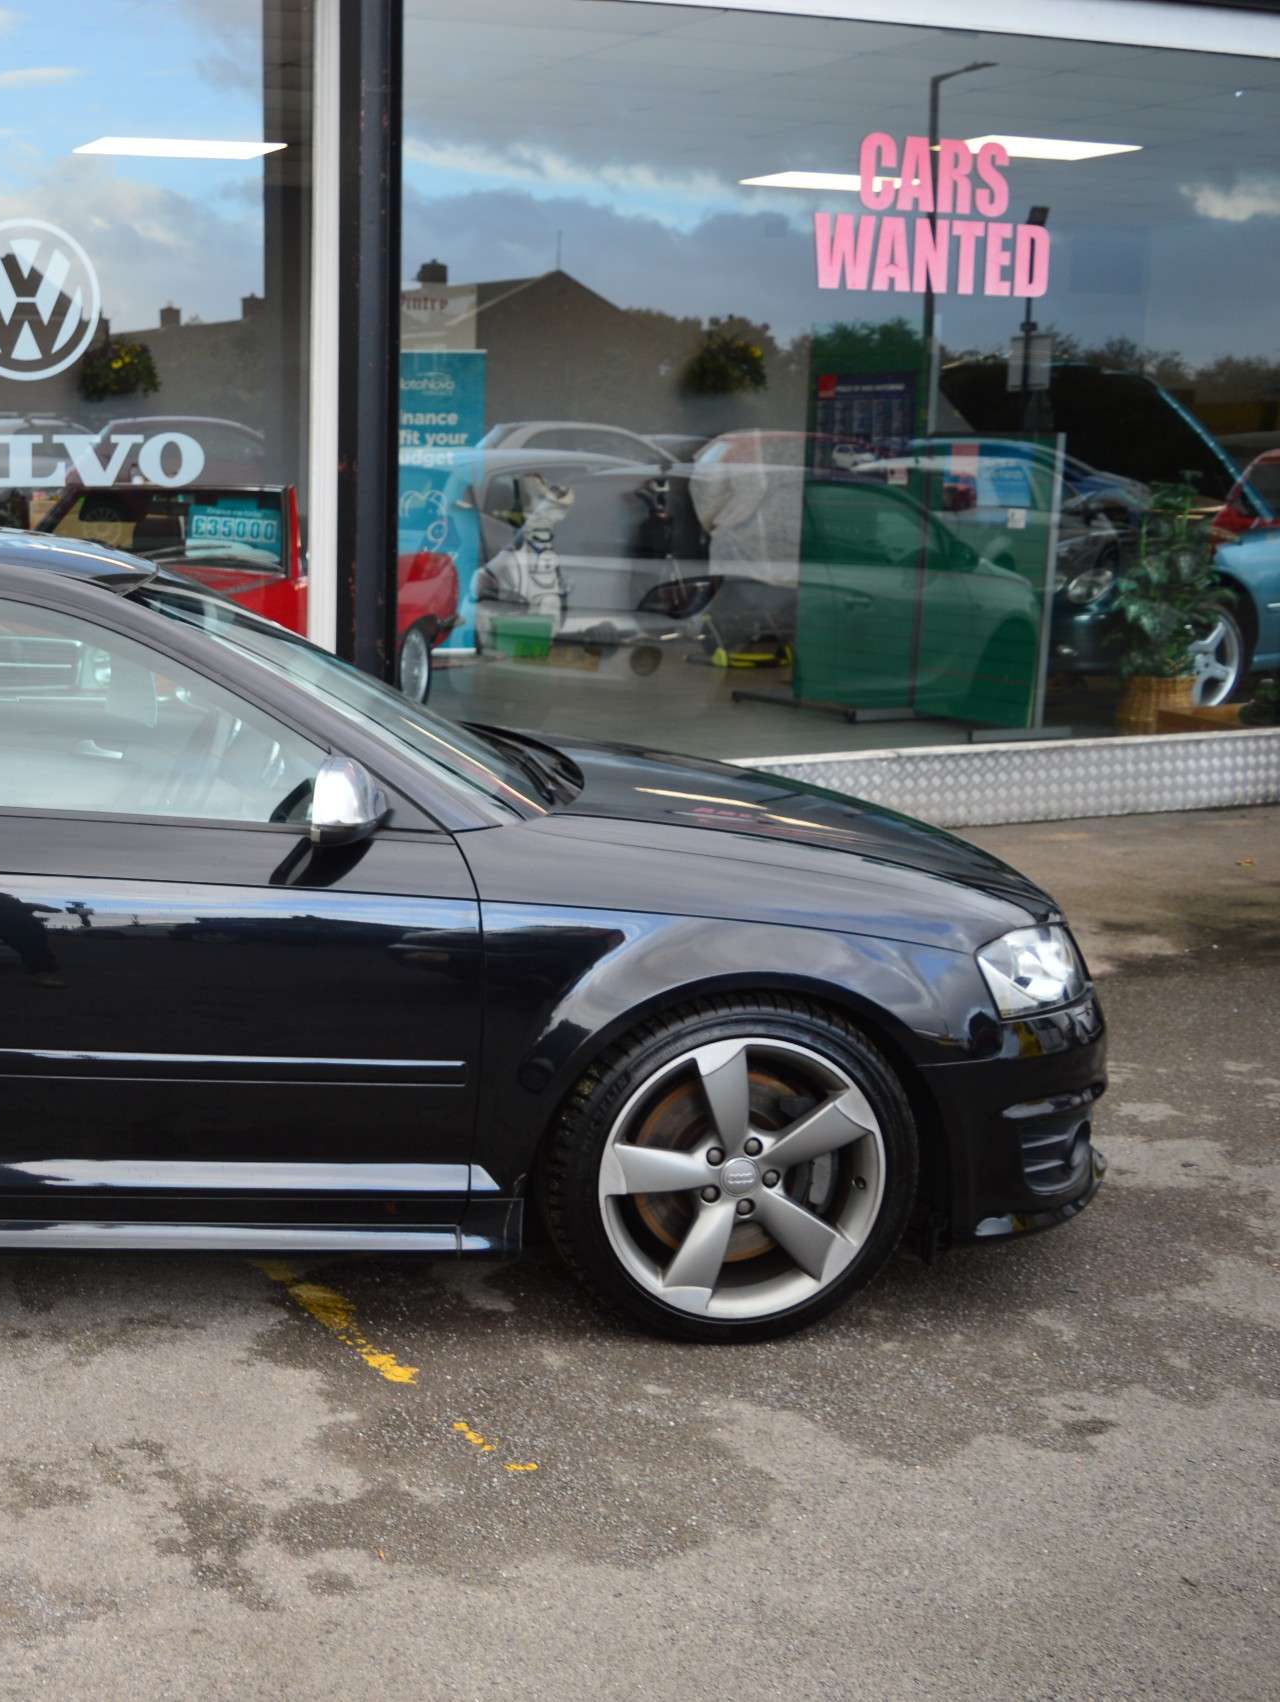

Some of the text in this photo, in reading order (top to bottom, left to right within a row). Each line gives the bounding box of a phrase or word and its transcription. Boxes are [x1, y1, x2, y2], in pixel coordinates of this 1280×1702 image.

[859, 132, 1011, 218] CARS
[814, 212, 1051, 298] WANTED
[423, 431, 469, 449] your
[194, 517, 276, 541] £35000
